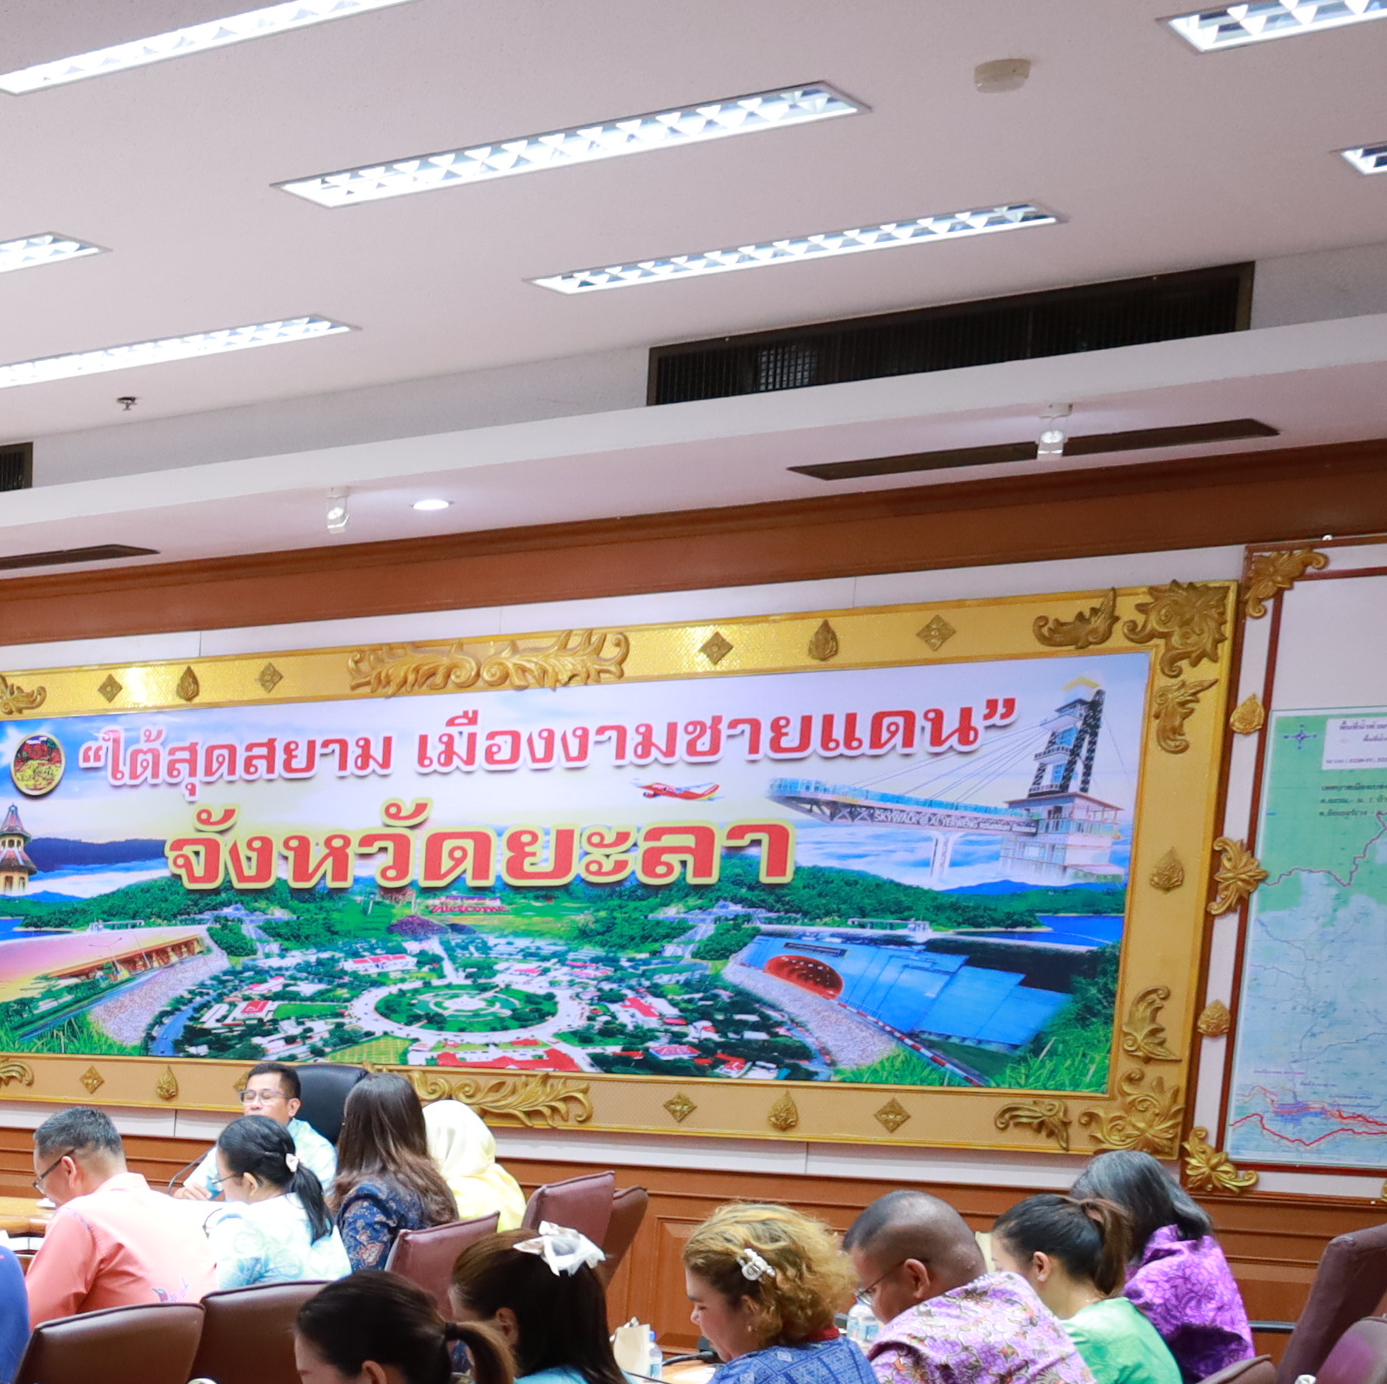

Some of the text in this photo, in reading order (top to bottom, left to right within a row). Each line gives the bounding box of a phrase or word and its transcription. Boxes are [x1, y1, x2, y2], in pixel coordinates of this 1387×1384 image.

[81, 697, 1016, 797] “ใต้สุดสยาม เมืองงามชายแดน”
[169, 800, 792, 887] จังหวัดยะลา
